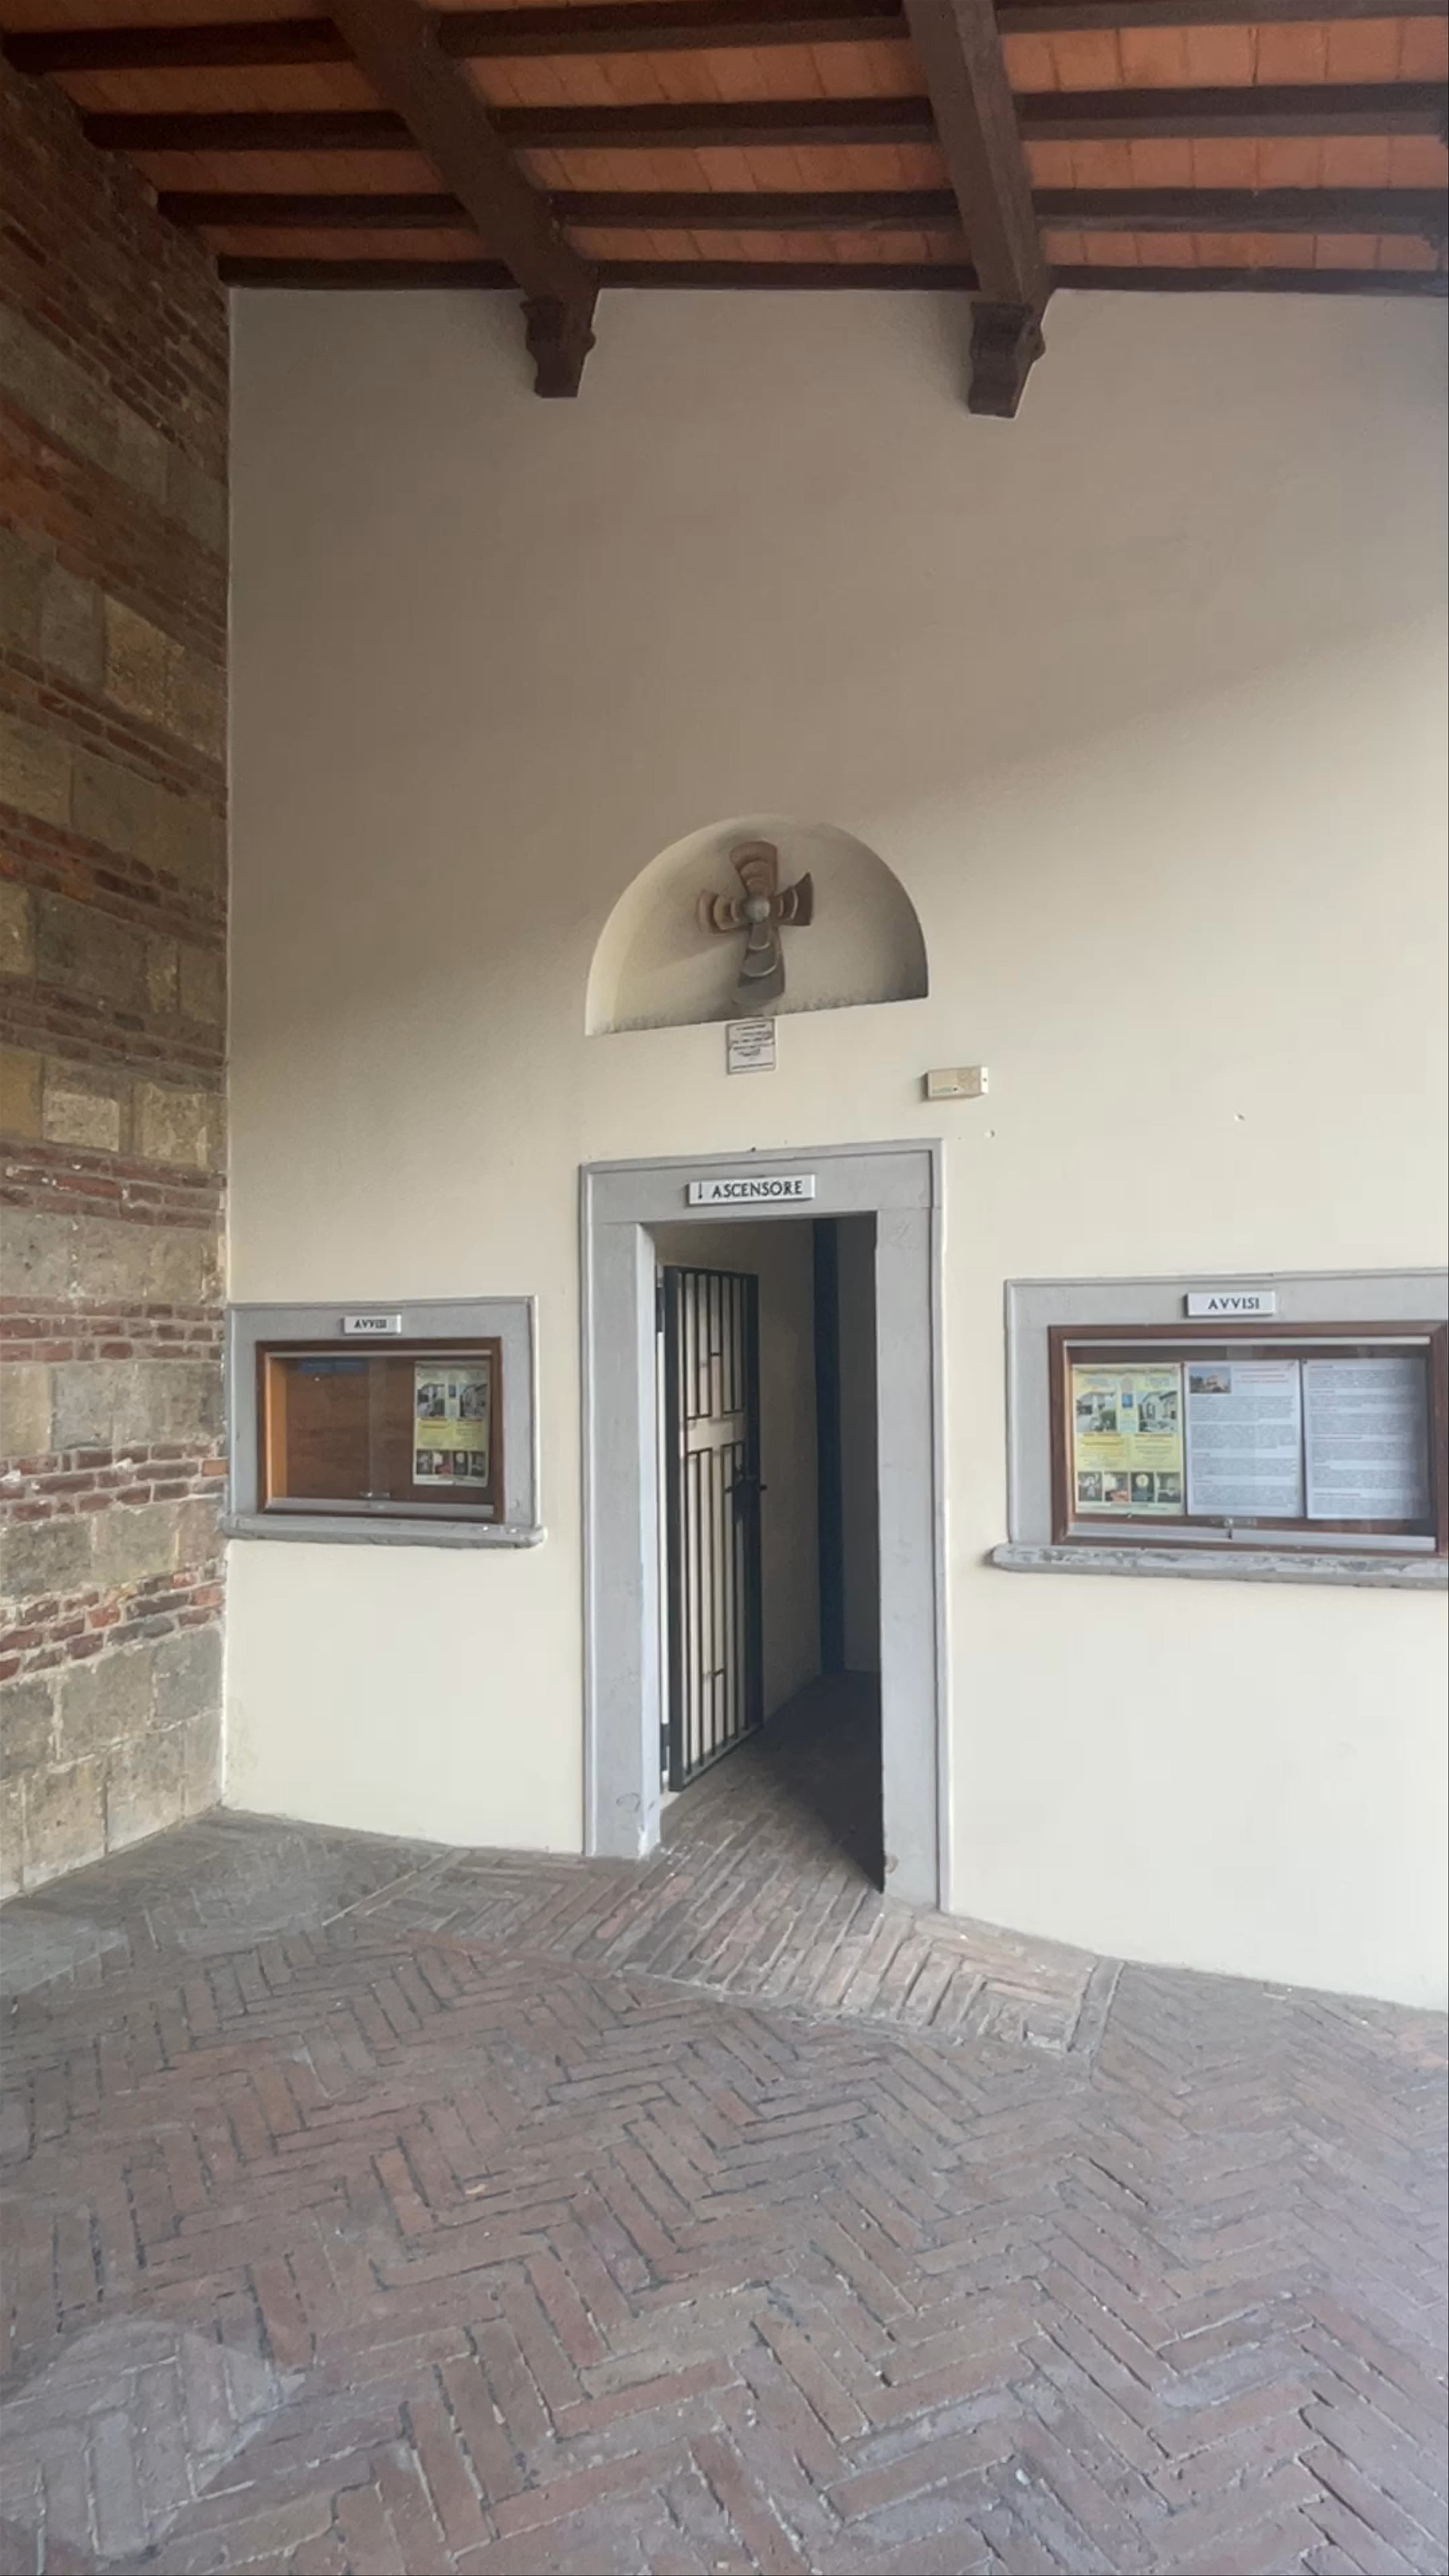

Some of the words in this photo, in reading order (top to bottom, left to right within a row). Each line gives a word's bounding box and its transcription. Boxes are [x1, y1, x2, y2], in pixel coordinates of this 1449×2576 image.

[712, 1180, 803, 1198] ASCENSORE
[1208, 1297, 1260, 1309] AVVISI
[354, 1319, 387, 1329] AVVISI
